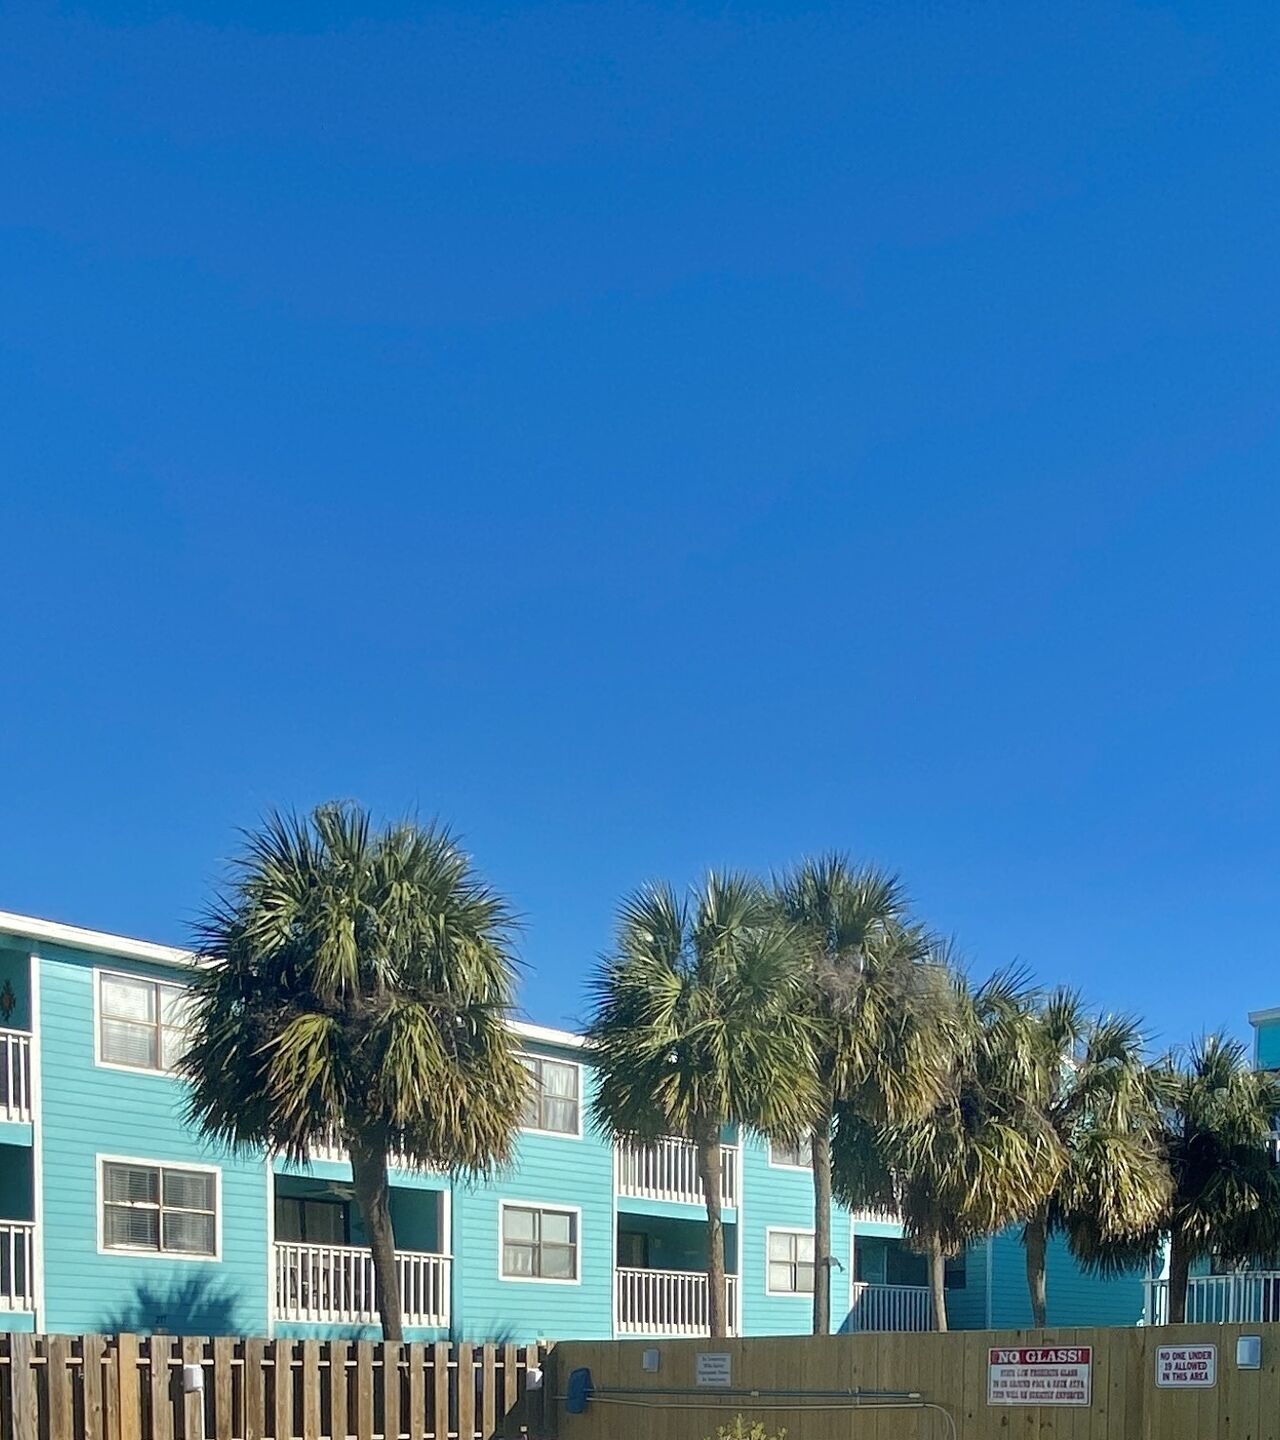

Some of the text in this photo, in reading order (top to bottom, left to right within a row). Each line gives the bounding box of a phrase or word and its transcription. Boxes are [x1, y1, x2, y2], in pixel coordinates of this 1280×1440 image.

[997, 1350, 1082, 1363] NO GLASS!
[1160, 1351, 1212, 1360] NO ONE UNDER
[1174, 1361, 1208, 1370] ALLOWED
[1162, 1372, 1209, 1381] IN THIS AREA
